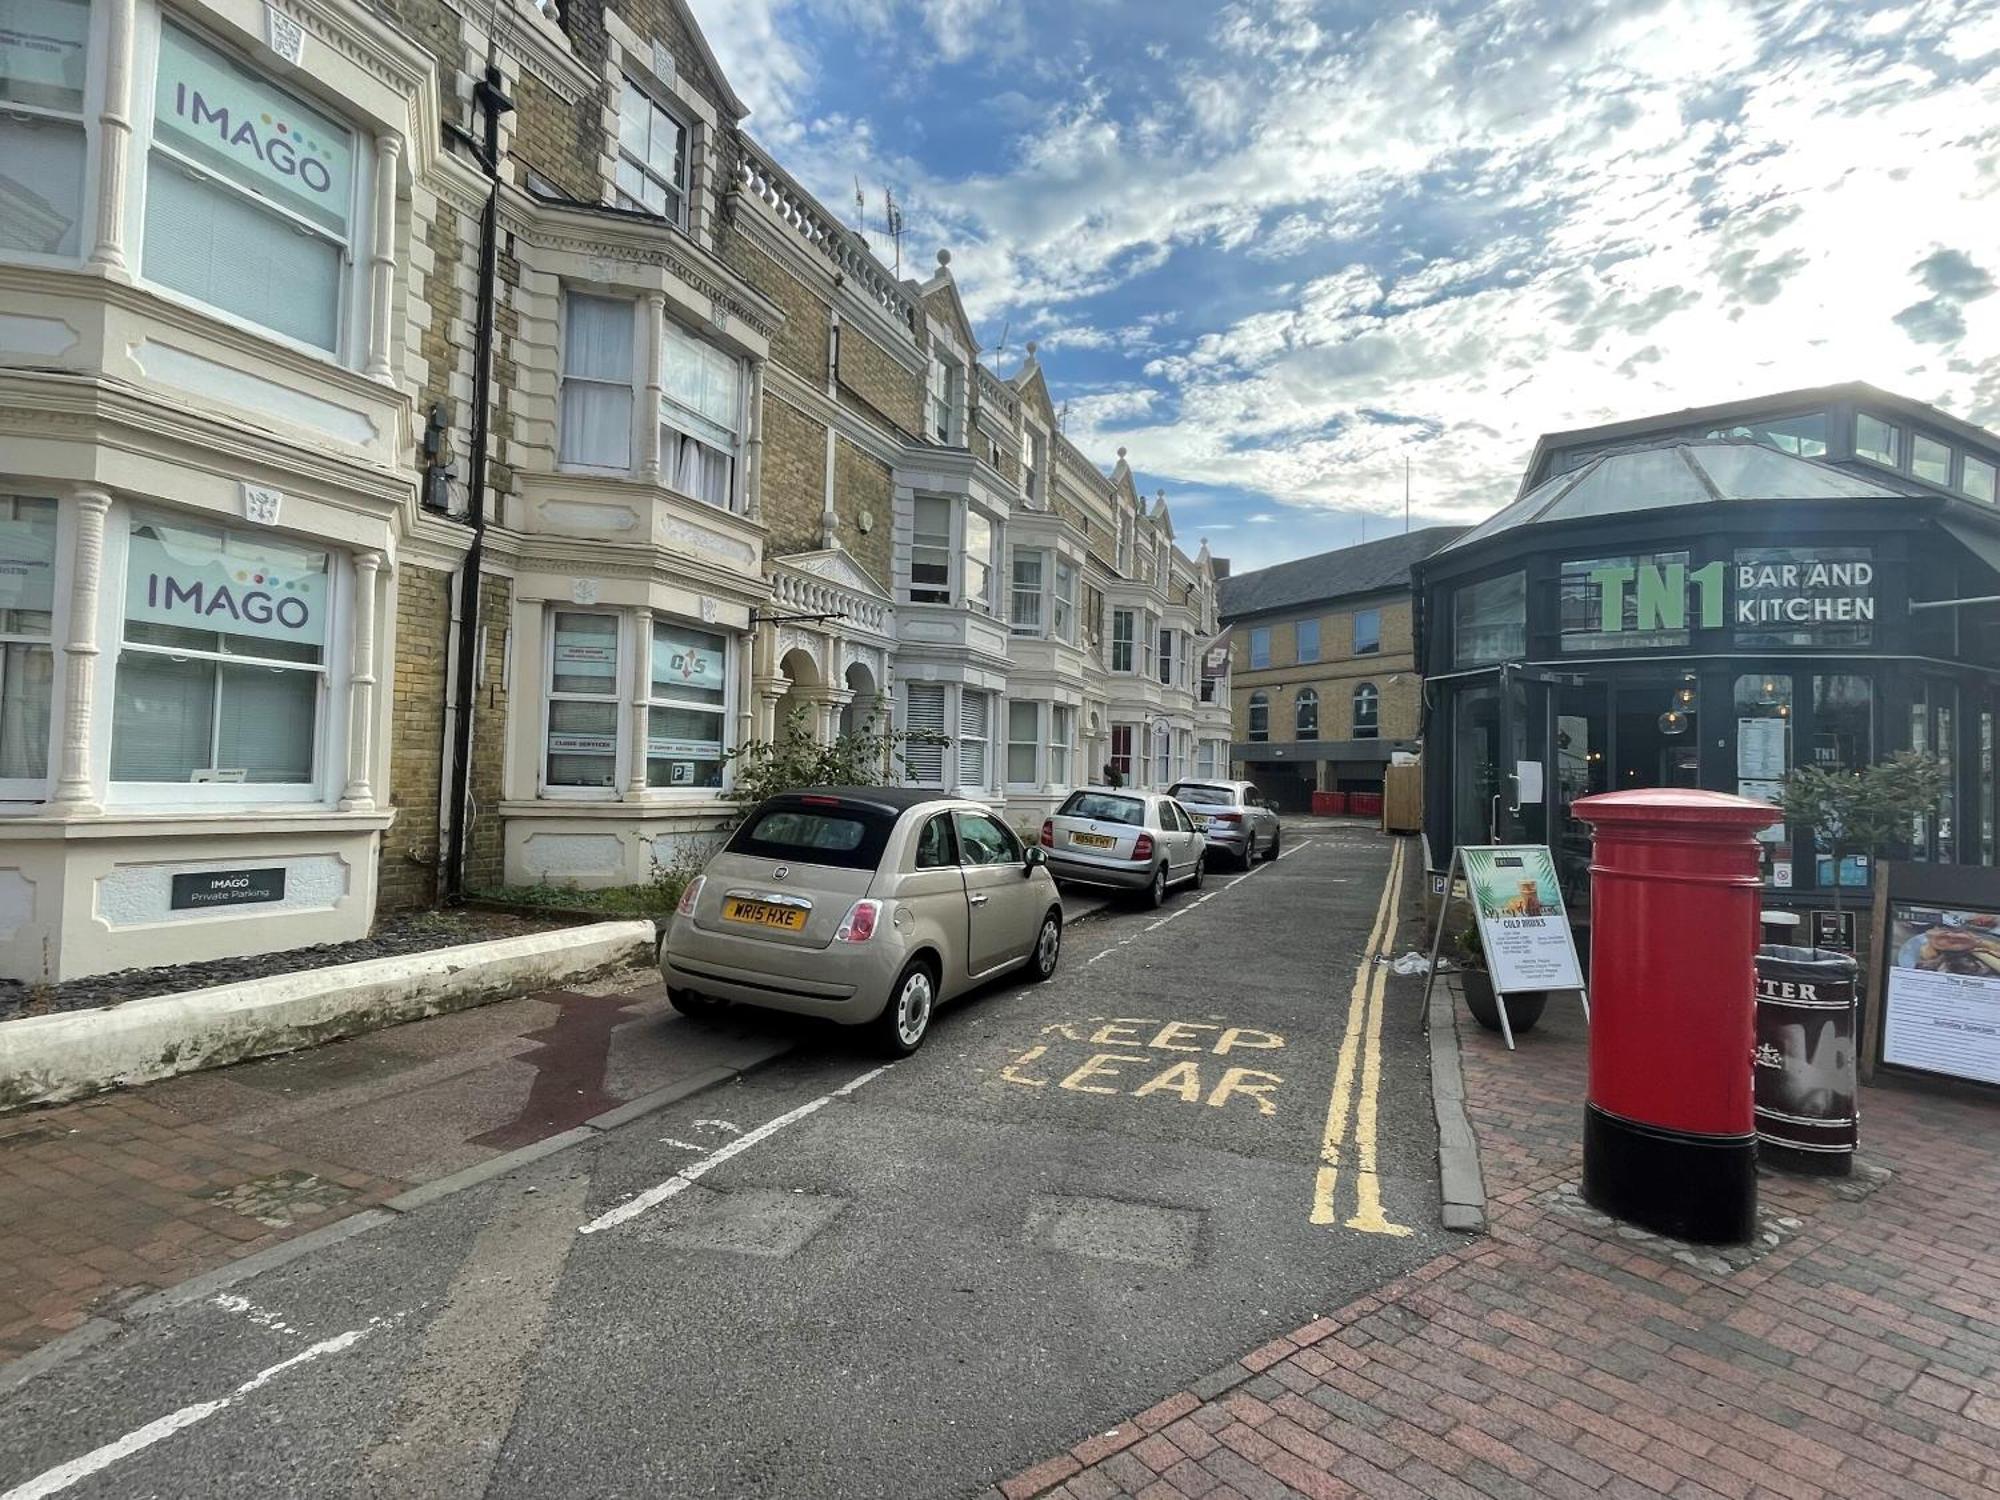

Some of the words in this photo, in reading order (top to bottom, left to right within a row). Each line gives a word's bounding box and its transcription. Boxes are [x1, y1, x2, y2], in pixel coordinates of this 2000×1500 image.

[176, 82, 331, 192] IMAGO
[1738, 564, 1798, 588] BAR
[1808, 562, 1873, 587] AND
[148, 573, 309, 629] IMAGO
[1588, 560, 1725, 632] TN1
[1738, 597, 1875, 623] KITCHEN
[191, 891, 229, 902] Private
[231, 888, 270, 899] Parking
[210, 878, 250, 889] IMAGO
[734, 902, 767, 921] WR15
[766, 907, 797, 926] HXE
[1756, 978, 1818, 1001] TER
